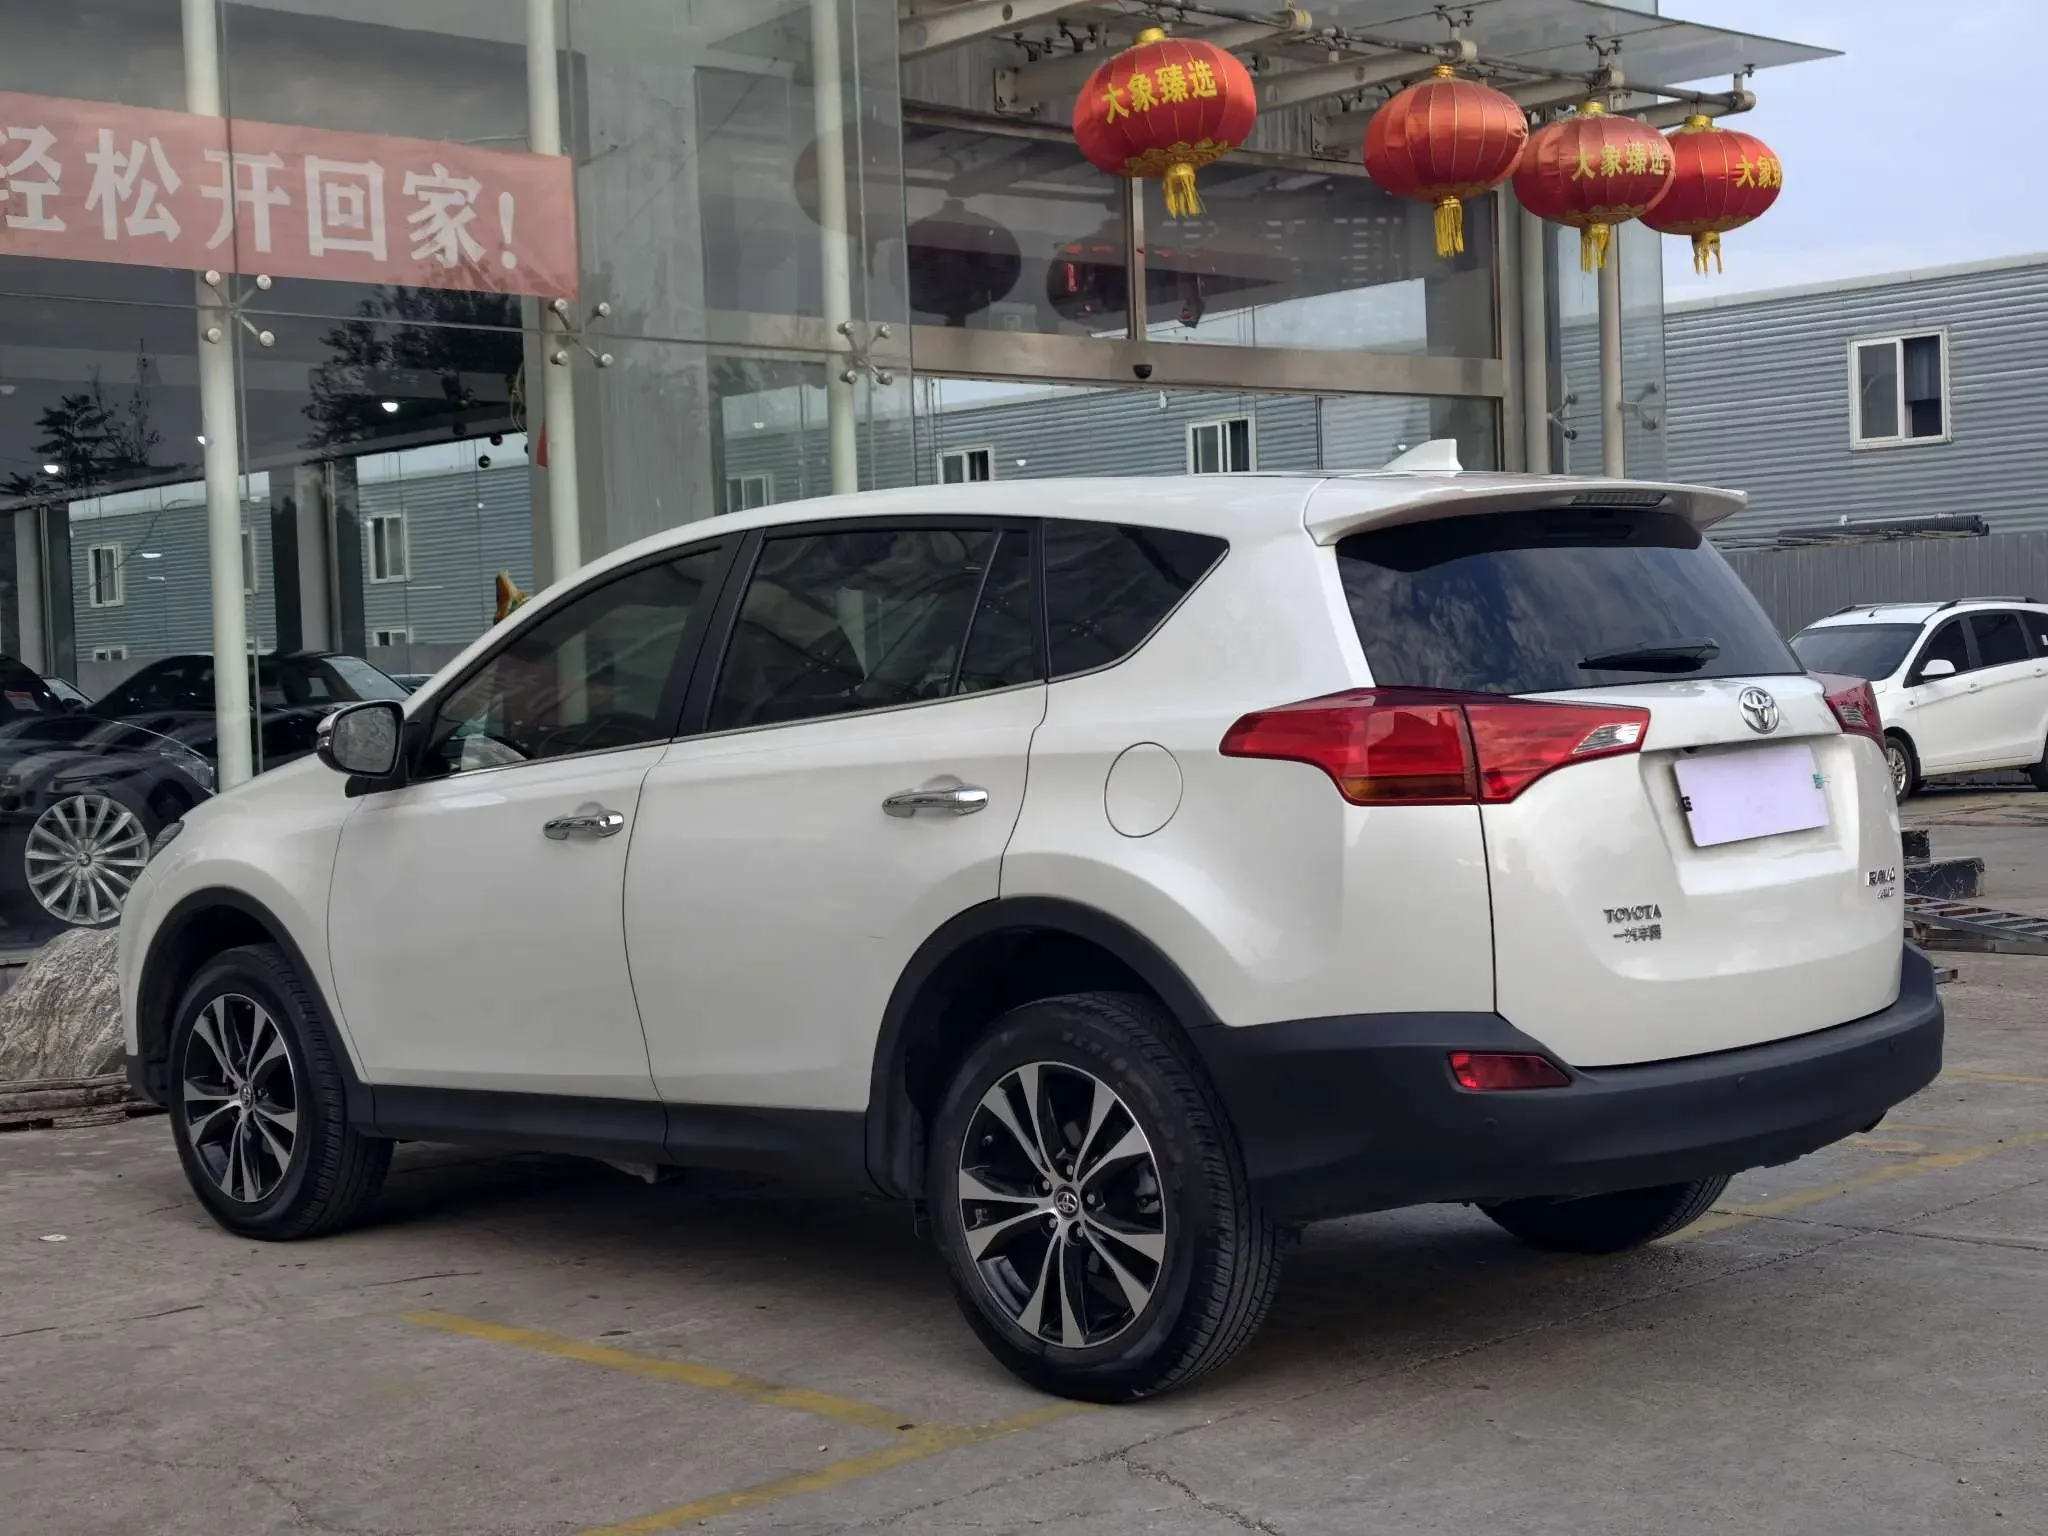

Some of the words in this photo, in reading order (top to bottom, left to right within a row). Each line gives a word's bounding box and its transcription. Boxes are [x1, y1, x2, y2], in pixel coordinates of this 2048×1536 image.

[1102, 59, 1217, 124] 大象臻选
[1603, 904, 1662, 924] TOYOTA
